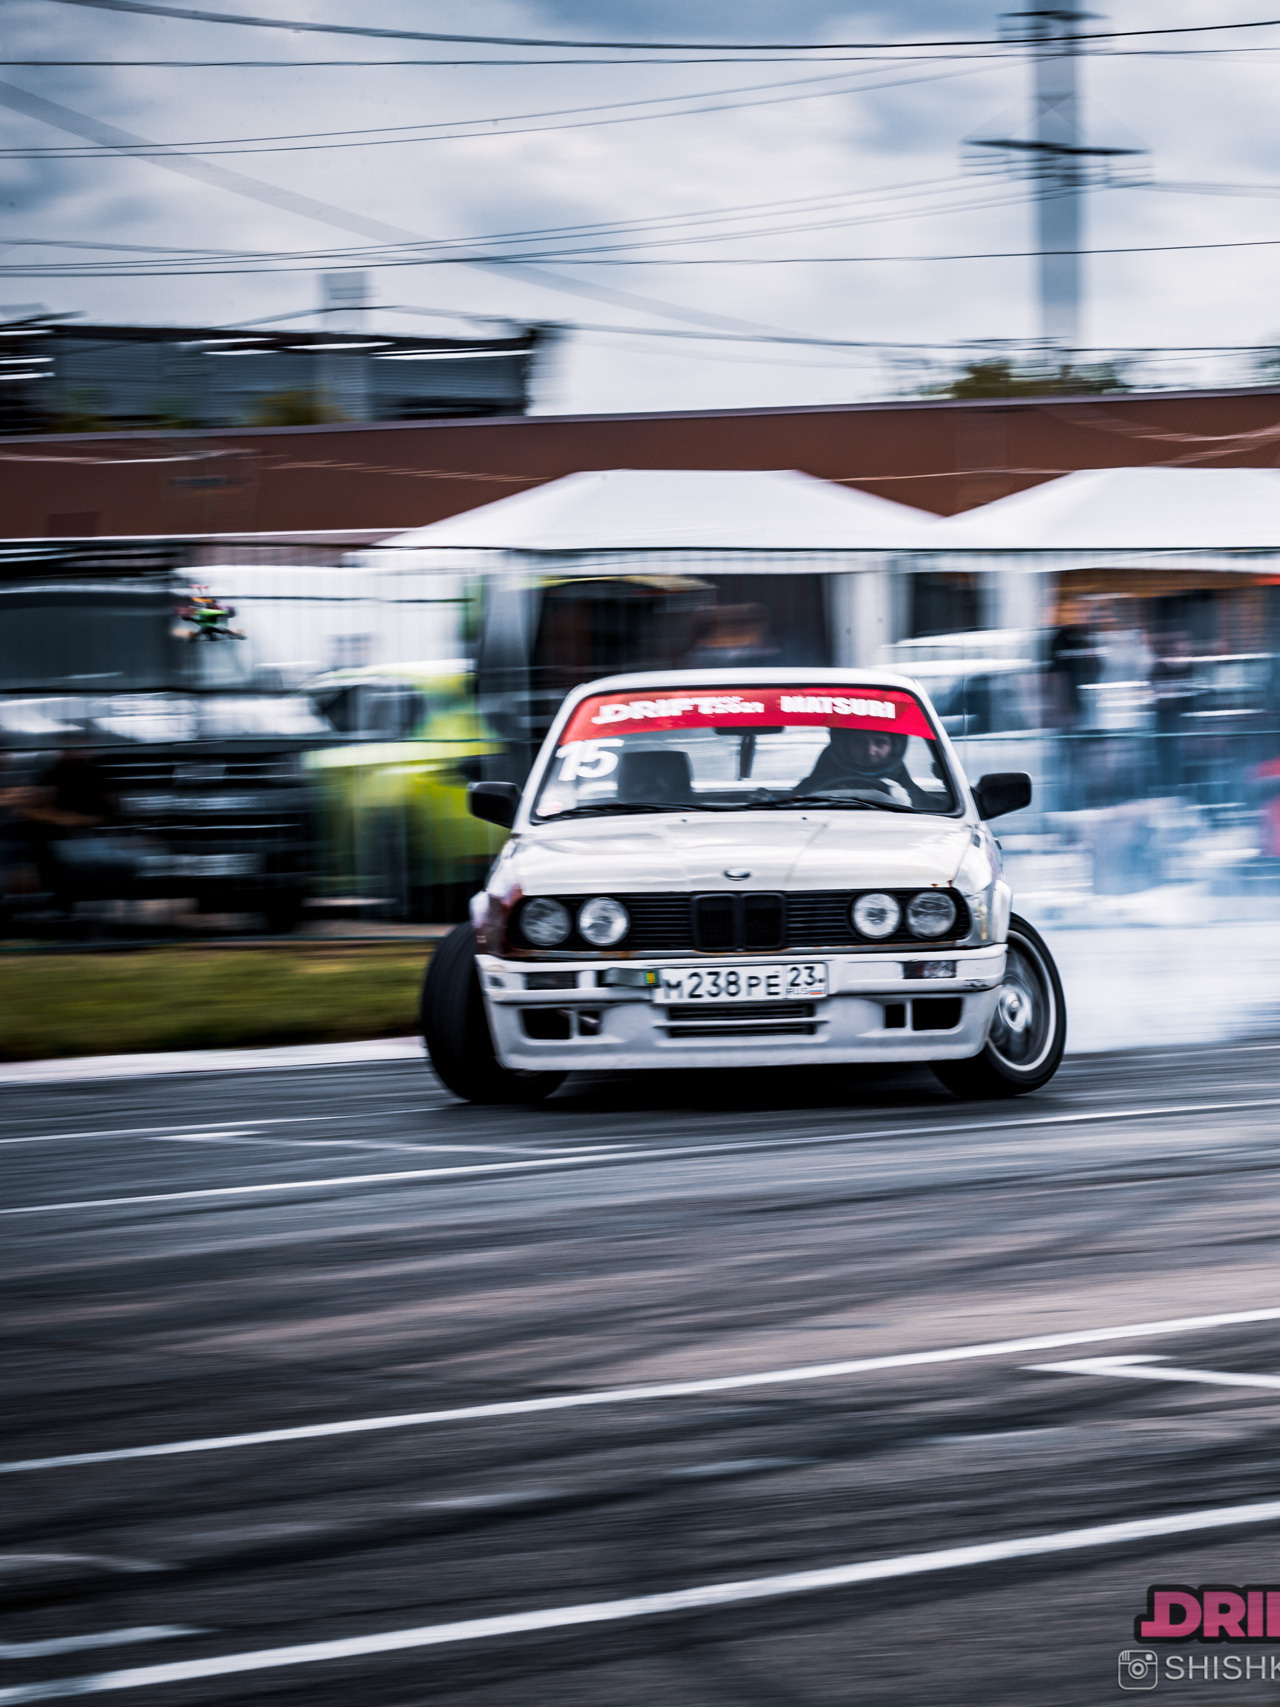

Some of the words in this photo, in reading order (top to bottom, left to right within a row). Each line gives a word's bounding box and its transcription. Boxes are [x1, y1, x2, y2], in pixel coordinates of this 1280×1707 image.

[592, 697, 716, 724] DRIFT
[780, 696, 896, 719] MATSURI
[555, 738, 624, 781] 15
[789, 966, 817, 987] 23
